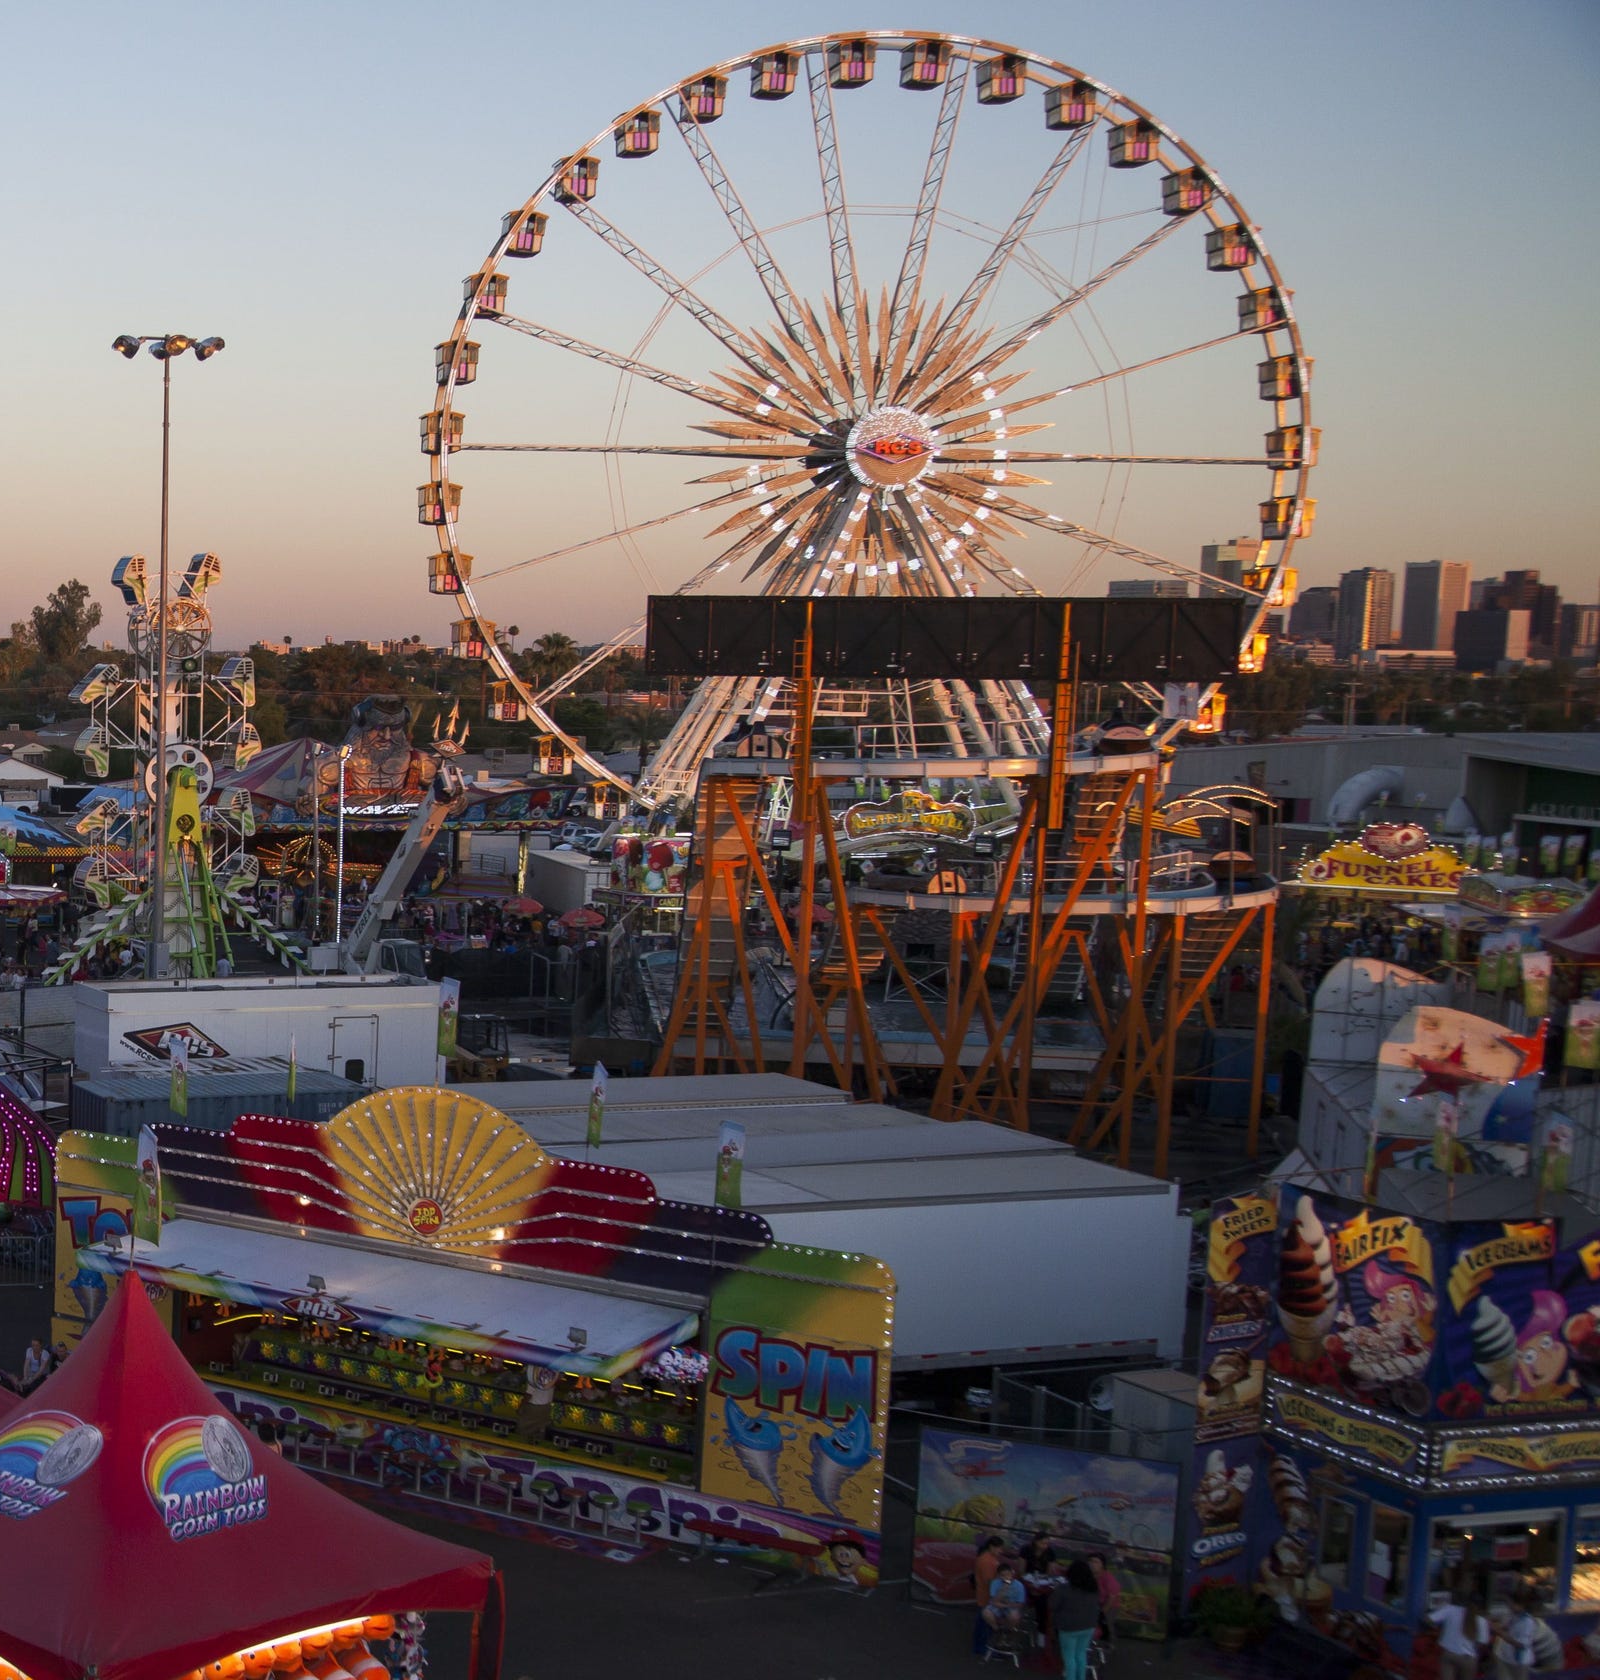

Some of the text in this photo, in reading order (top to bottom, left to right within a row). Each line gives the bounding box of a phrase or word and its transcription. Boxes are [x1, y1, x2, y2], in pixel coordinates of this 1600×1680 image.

[875, 440, 922, 454] RCS
[1326, 857, 1440, 879] FUNNEL
[1366, 871, 1461, 889] CAKES
[120, 1040, 158, 1061] www.RCS
[1222, 1204, 1266, 1230] FRIED
[1222, 1215, 1272, 1242] SWEETS
[295, 1299, 343, 1321] RCS
[711, 1326, 878, 1424] SPIN
[162, 1474, 267, 1525] RAINBOW
[169, 1499, 268, 1542] COIN TOSS
[1191, 1532, 1248, 1556] OREO
